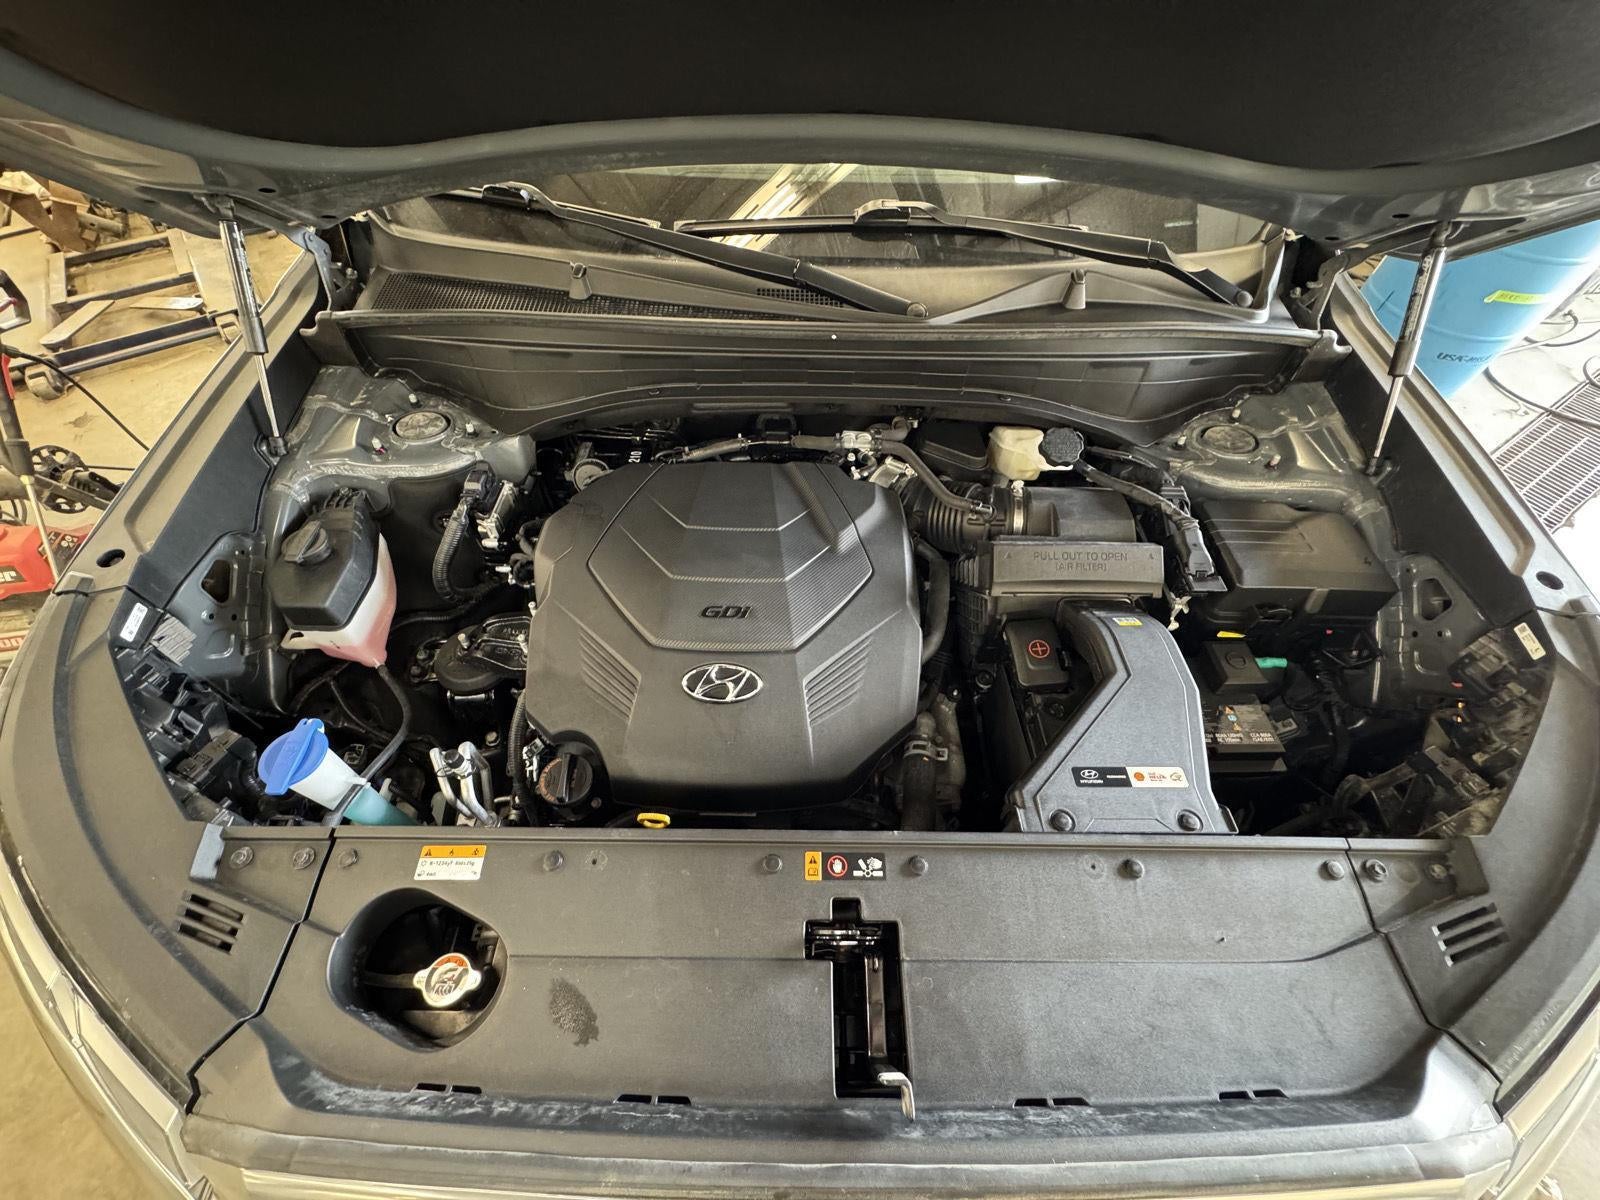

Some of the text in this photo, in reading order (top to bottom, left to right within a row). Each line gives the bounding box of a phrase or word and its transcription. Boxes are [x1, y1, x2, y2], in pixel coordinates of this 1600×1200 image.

[1033, 551, 1128, 561] PULL OUT TO OPEN
